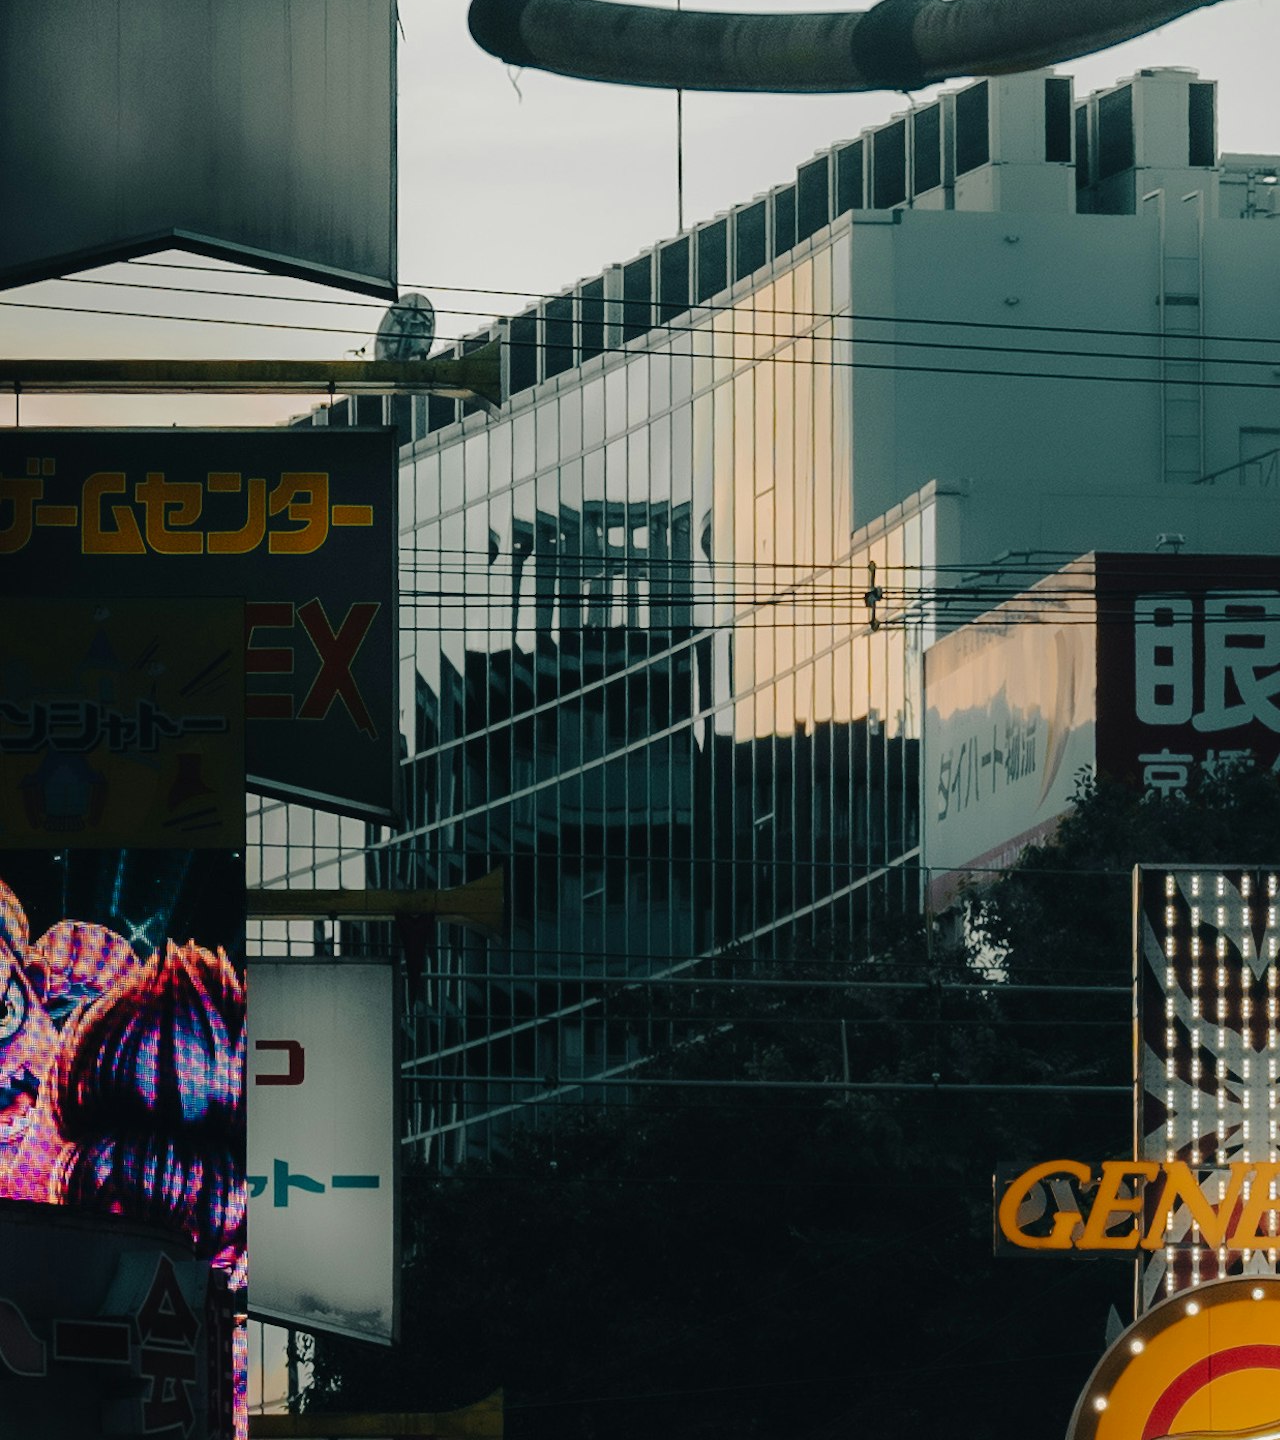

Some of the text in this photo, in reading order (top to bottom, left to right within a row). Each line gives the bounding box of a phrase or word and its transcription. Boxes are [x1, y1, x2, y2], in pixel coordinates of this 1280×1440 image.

[0, 457, 374, 555] ゲームセンター
